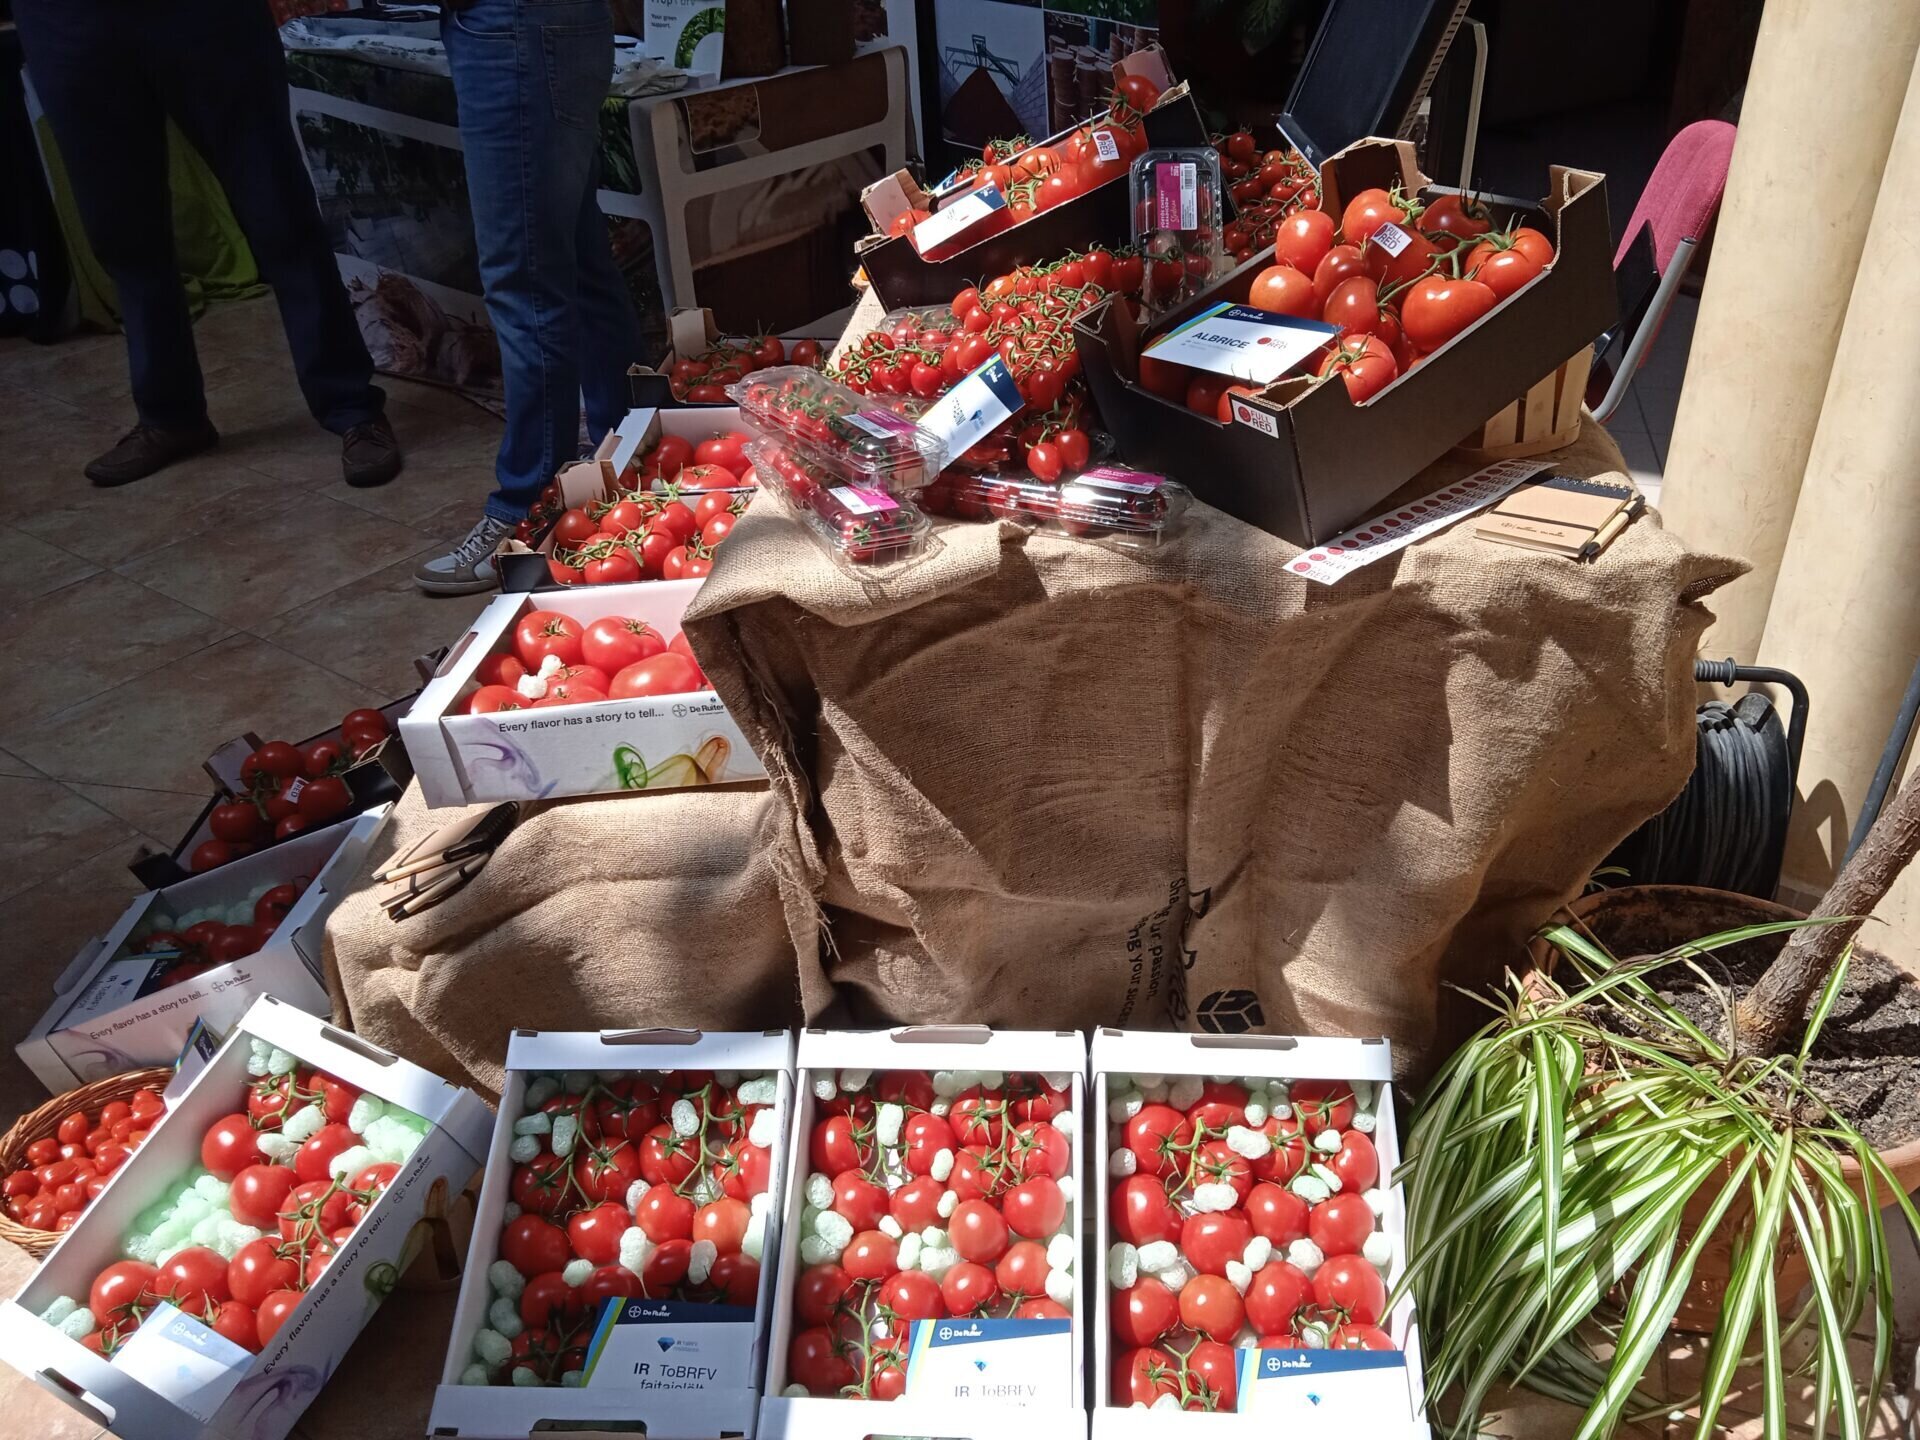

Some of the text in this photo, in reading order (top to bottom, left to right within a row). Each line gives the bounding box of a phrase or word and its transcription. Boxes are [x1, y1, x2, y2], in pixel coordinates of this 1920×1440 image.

[1097, 142, 1110, 156] RED
[1107, 140, 1116, 155] FULL
[1377, 232, 1397, 249] RED
[1386, 226, 1403, 243] FULL
[1192, 331, 1250, 349] ALBRICE
[1250, 410, 1271, 425] FULL
[1252, 418, 1272, 432] RED
[1306, 569, 1331, 581] RED
[701, 703, 724, 712] Ruiter
[499, 721, 528, 733] Every
[530, 719, 560, 730] flavor
[563, 715, 583, 726] has
[585, 716, 593, 724] a
[595, 712, 622, 724] story
[625, 709, 636, 720] to
[638, 707, 664, 718] tell...
[1130, 954, 1143, 985] your
[224, 973, 251, 987] De Ruiter
[1116, 989, 1138, 1028] succes
[90, 1026, 113, 1040] Every
[112, 1017, 136, 1031] flavor
[136, 1011, 152, 1022] has
[158, 1001, 179, 1014] story
[178, 996, 188, 1005] to
[404, 1155, 431, 1188] De Ruiter
[263, 1212, 390, 1375] Every flavor has a story to tell...
[652, 1310, 672, 1318] Ruiter
[633, 1362, 718, 1381] IR ToBRFV
[1292, 1361, 1312, 1369] Ruiter
[954, 1384, 1037, 1398] IR ToBRFV
